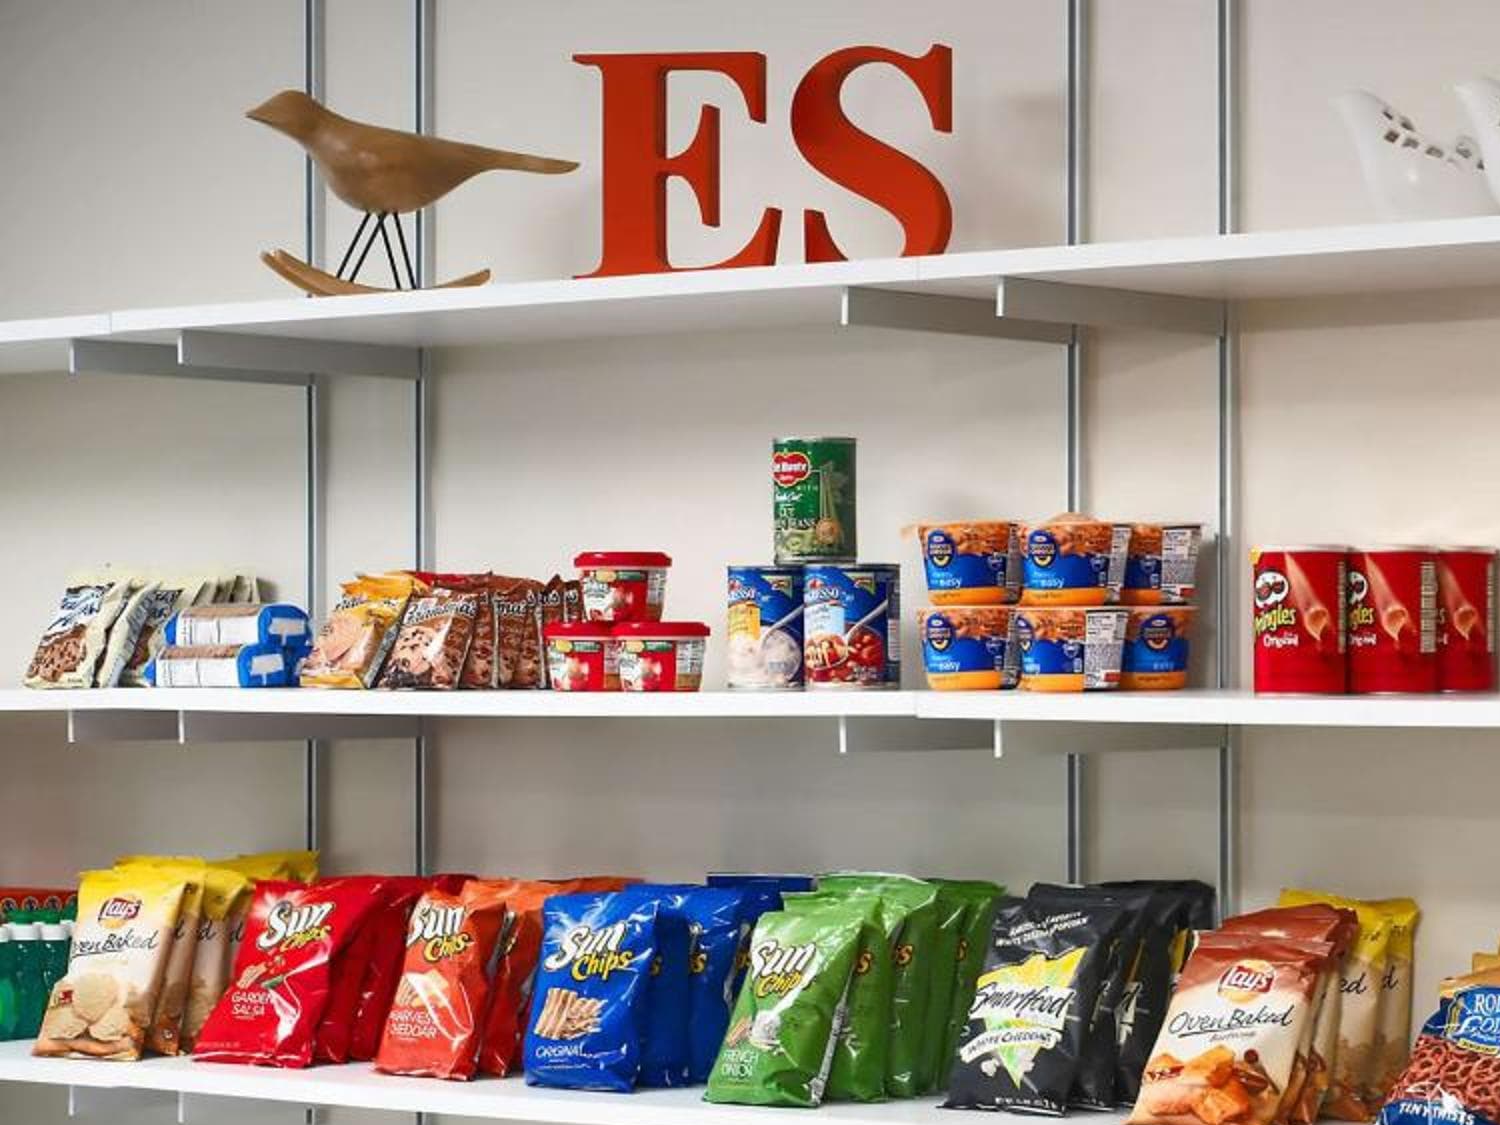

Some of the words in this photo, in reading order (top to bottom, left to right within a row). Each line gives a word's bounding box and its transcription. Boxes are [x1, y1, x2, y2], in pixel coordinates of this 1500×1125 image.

[573, 44, 953, 281] ES
[1254, 605, 1296, 633] ringles
[256, 900, 335, 951] Sun
[406, 901, 467, 948] Sun
[544, 920, 628, 972] Sun
[751, 939, 817, 979] Sun
[571, 950, 633, 983] Chips
[756, 971, 804, 999] Chip
[969, 980, 1076, 1018] Smartfood
[1168, 1012, 1223, 1034] Oven
[1228, 1004, 1296, 1028] Baked
[1399, 1102, 1428, 1117] TINY
